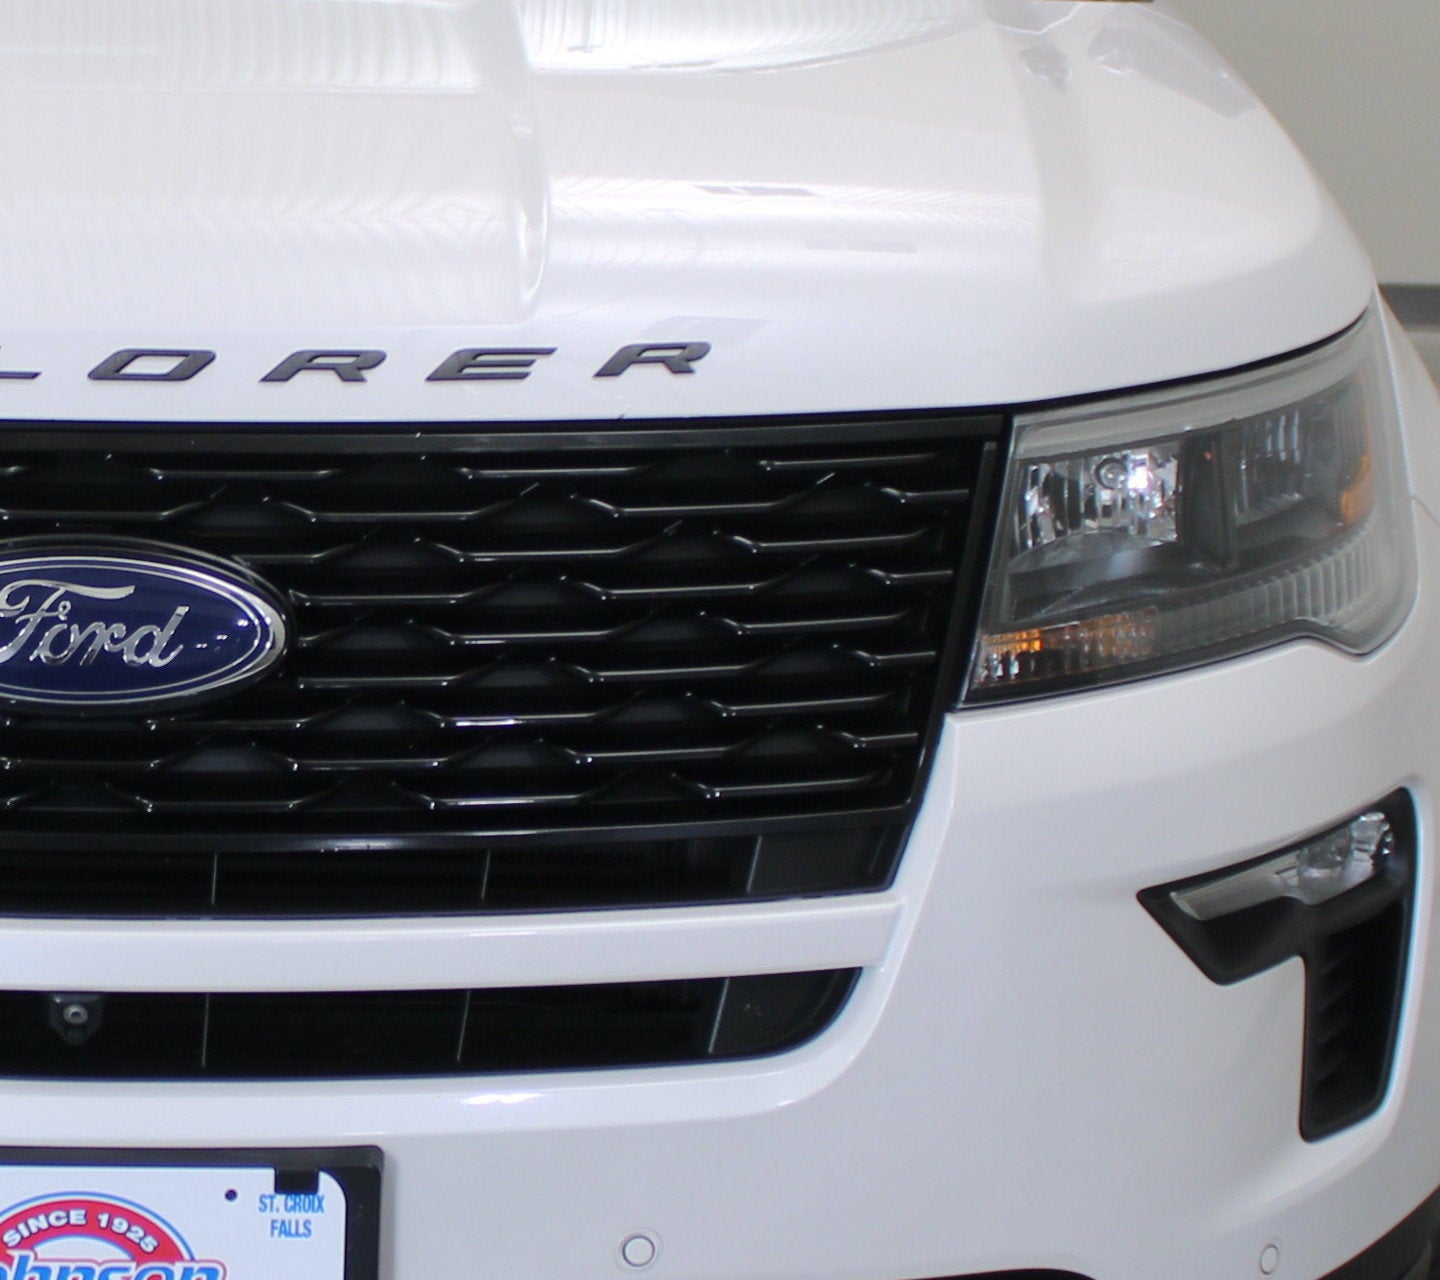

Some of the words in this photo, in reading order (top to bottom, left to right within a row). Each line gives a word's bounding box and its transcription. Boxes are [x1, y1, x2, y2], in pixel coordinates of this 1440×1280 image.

[258, 1193, 280, 1213] ST.
[284, 1193, 325, 1213] CROIX
[1, 1208, 88, 1248] SINCE
[96, 1212, 159, 1254] 1925
[270, 1219, 312, 1238] FALLS
